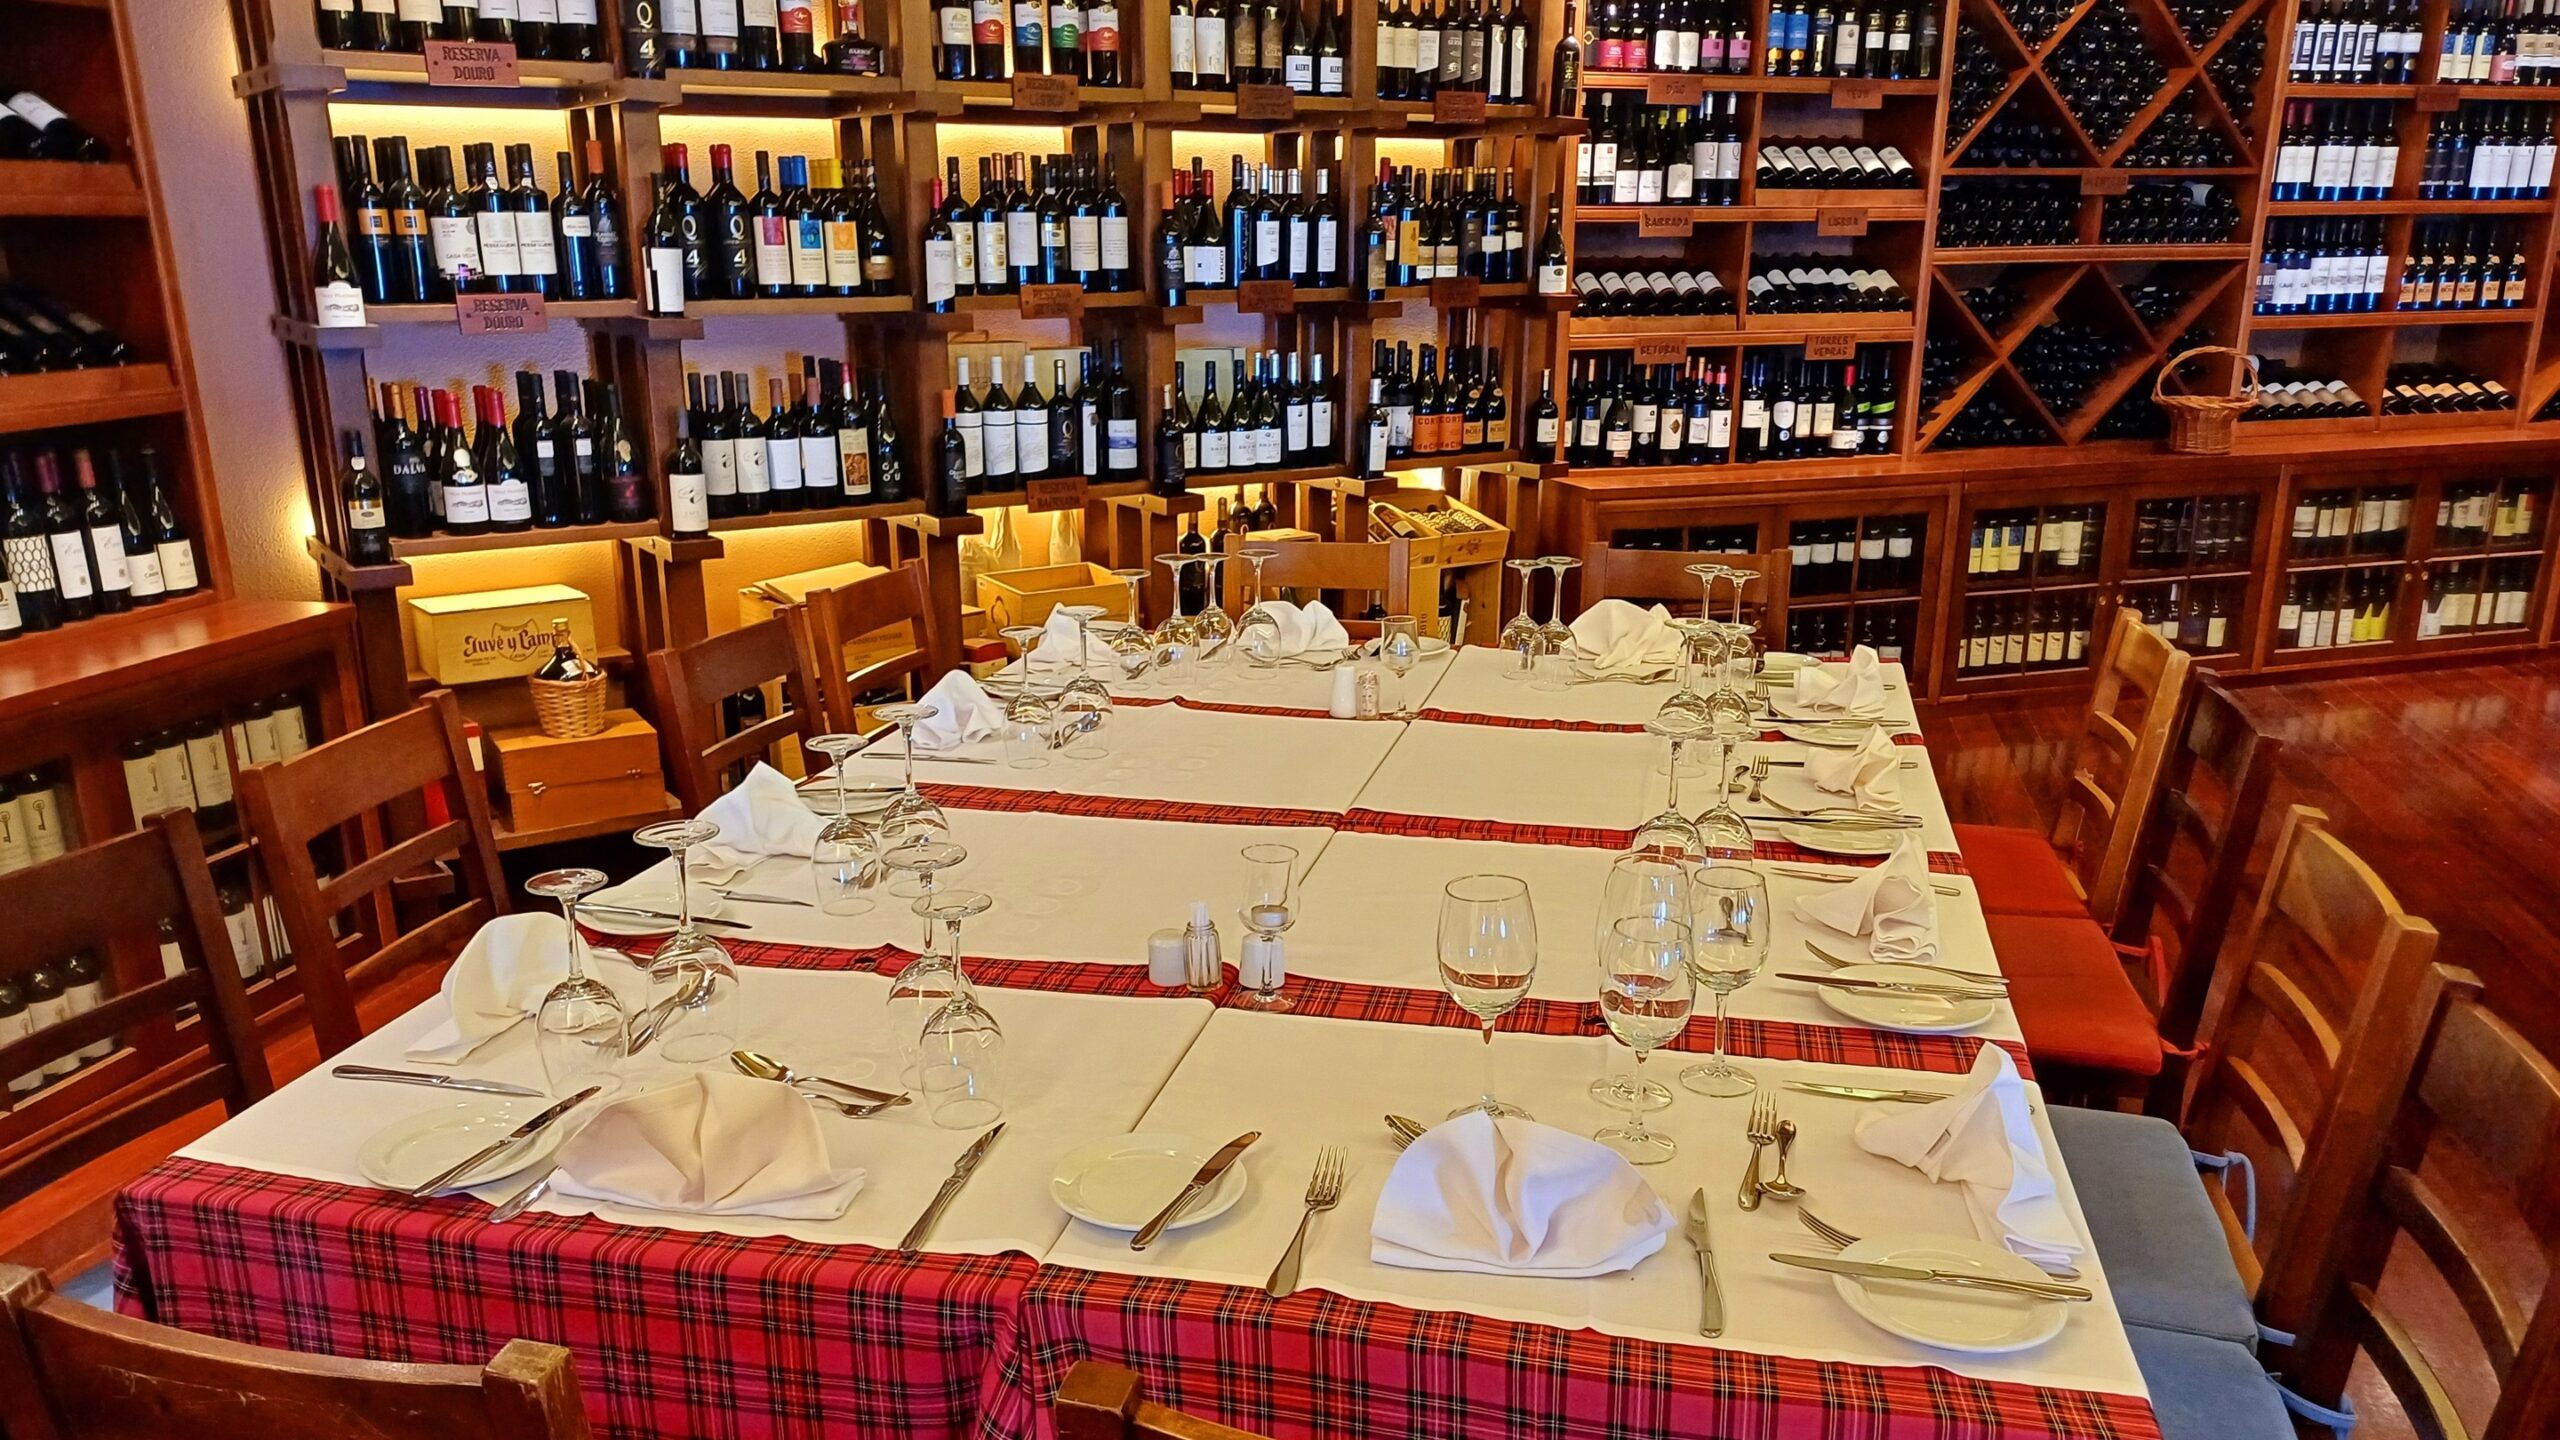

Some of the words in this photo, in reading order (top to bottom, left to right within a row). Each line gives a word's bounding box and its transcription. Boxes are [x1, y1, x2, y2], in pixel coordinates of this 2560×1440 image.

[442, 45, 502, 63] RESERVA
[453, 65, 496, 81] DOURO
[729, 214, 745, 241] Q
[732, 248, 748, 267] 4
[473, 298, 531, 315] RESERVA
[483, 315, 524, 331] DOURO
[507, 637, 517, 656] y
